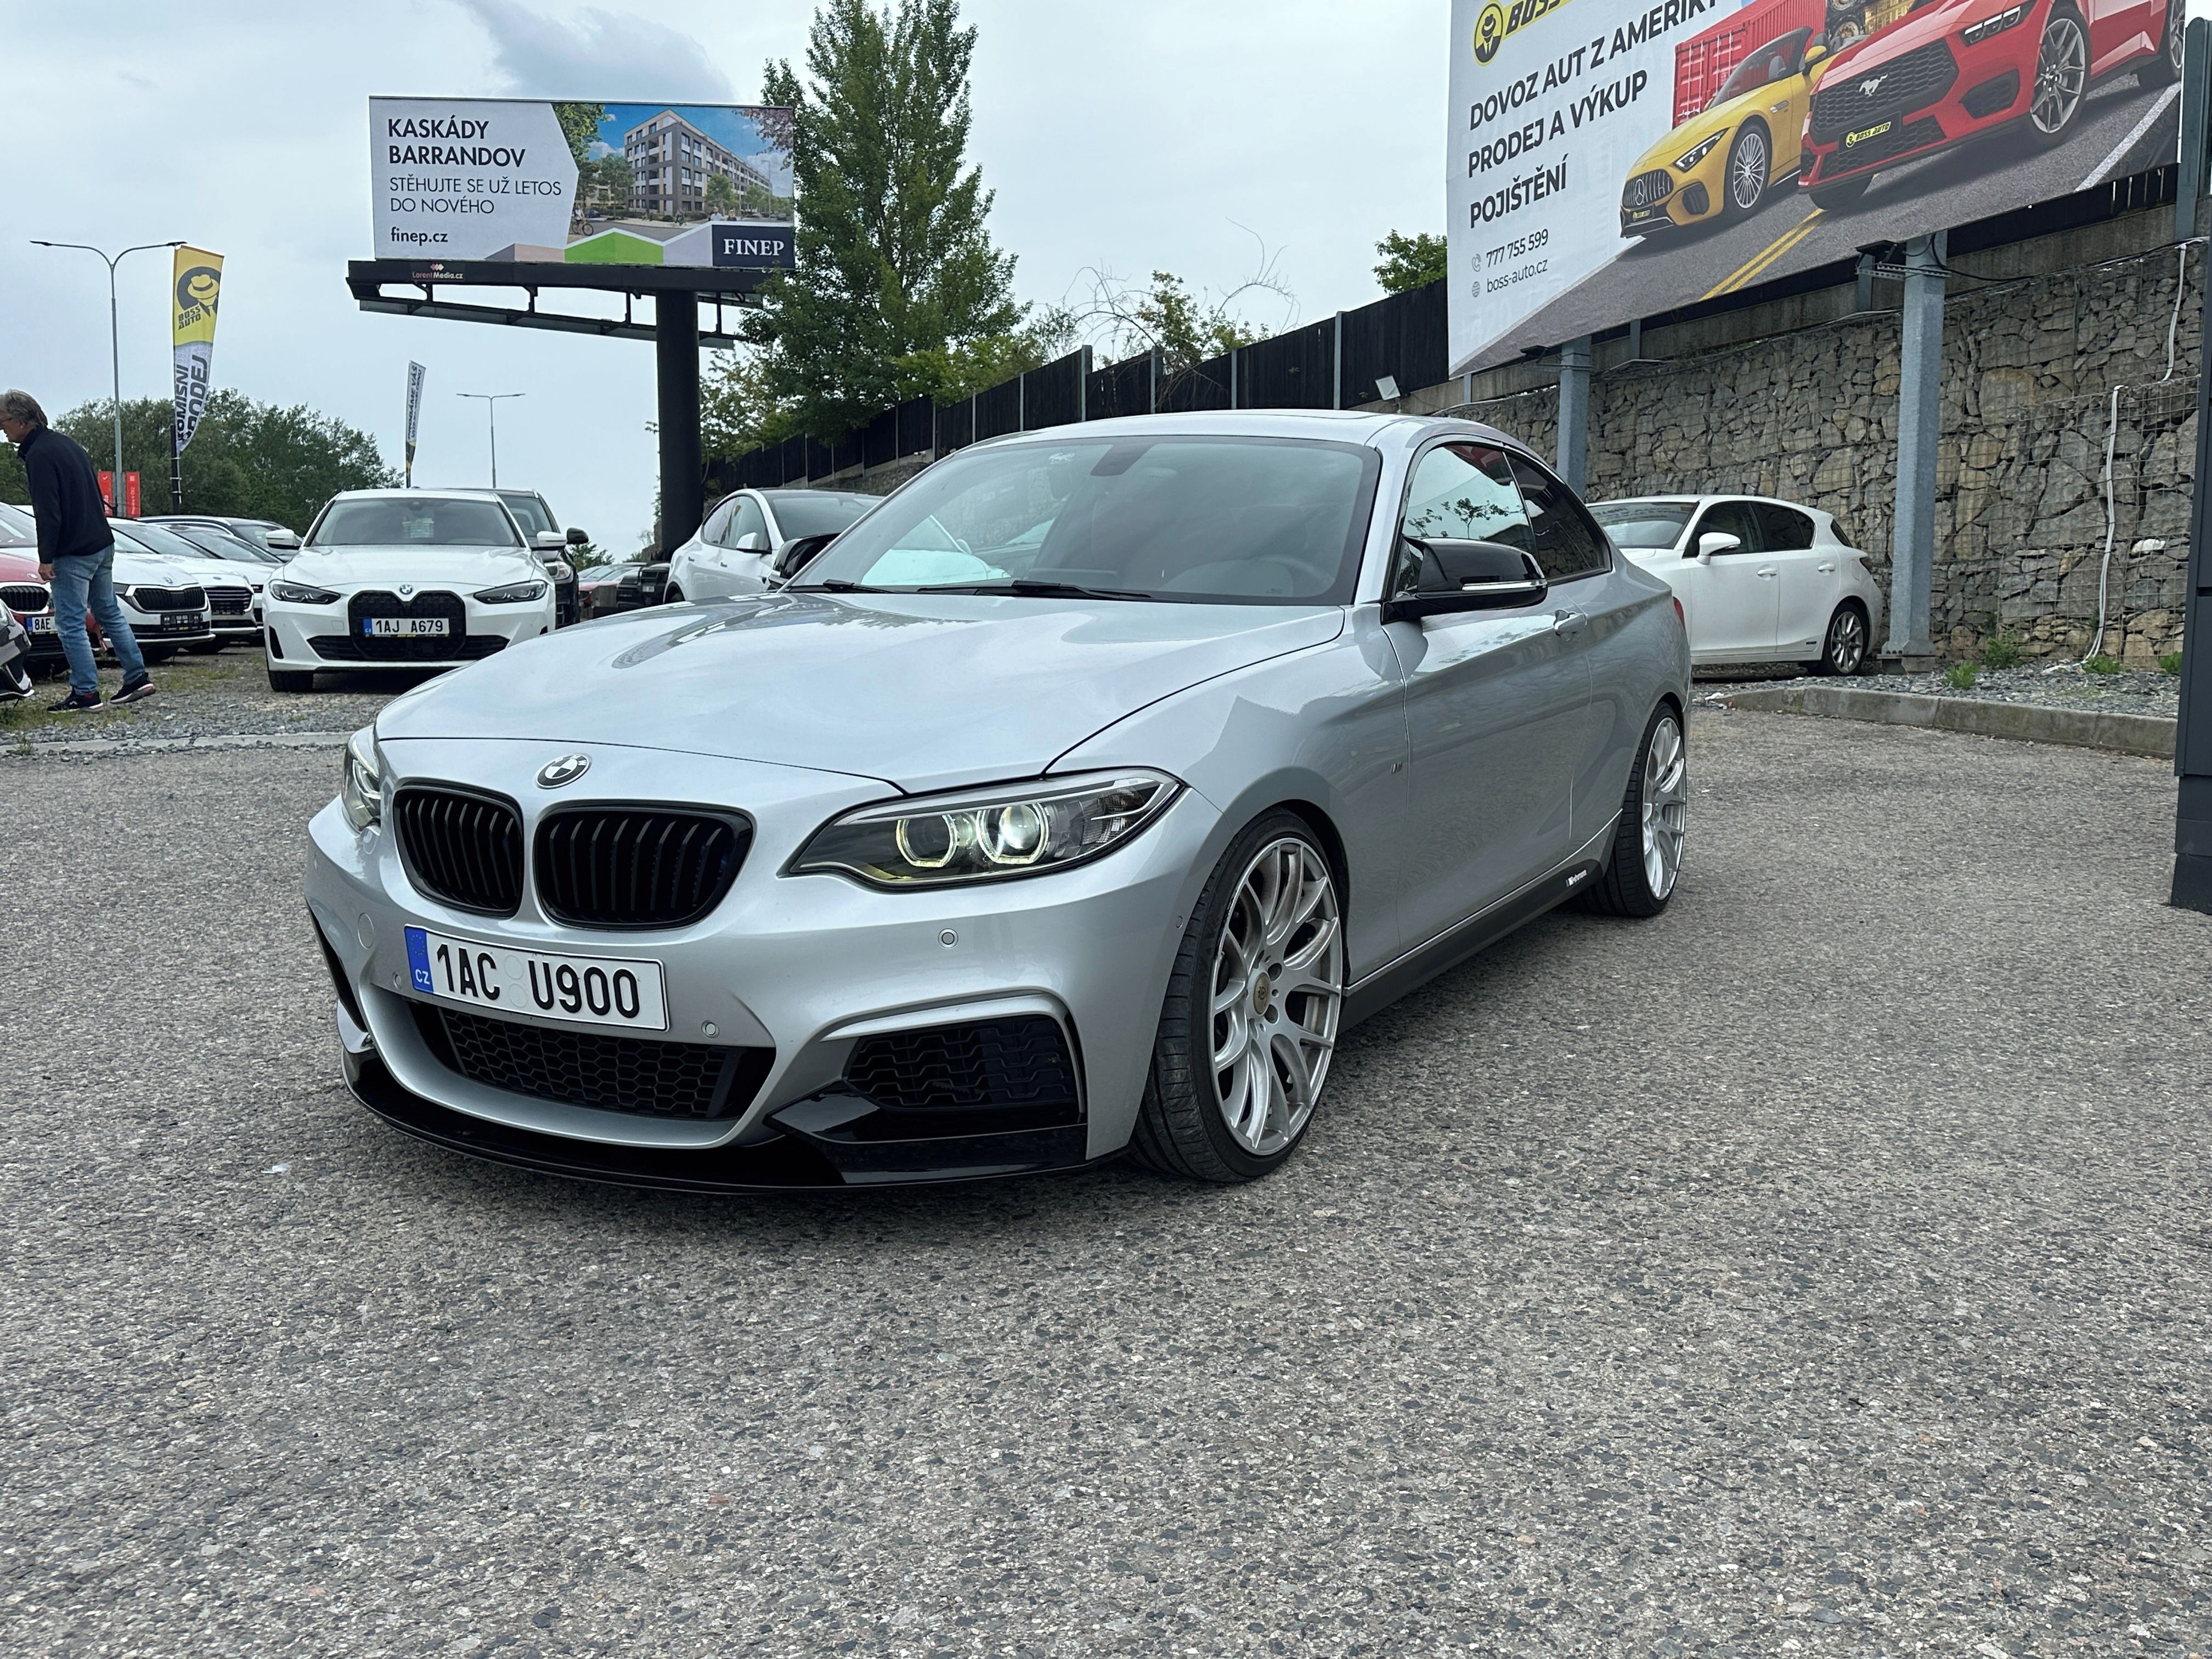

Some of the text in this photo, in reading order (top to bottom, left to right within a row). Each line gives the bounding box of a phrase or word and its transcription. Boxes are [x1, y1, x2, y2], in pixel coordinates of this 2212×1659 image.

[1470, 0, 1716, 131] DOVOZ AUT Z AMERIK
[388, 115, 490, 139] KASKÁDY
[1469, 70, 1647, 178] PRODEJ A VÝKUP
[389, 145, 526, 167] BARRANDOV
[390, 173, 561, 195] STĚHUJTE SE UŽ LETOS
[1470, 153, 1568, 229] POJIŠTĚNÍ
[391, 195, 494, 214] DO NOVÉHO
[391, 227, 448, 246] finep.cz
[723, 239, 785, 256] FINEP
[1486, 229, 1548, 268] 777 755 599
[1487, 259, 1548, 293] boss-auto.cz
[178, 306, 201, 322] BOSS
[178, 313, 201, 330] AUTO
[35, 618, 51, 630] 8AE
[376, 620, 443, 633] 1AJ A679
[414, 968, 430, 985] CZ
[437, 943, 640, 1018] 1AC U900
